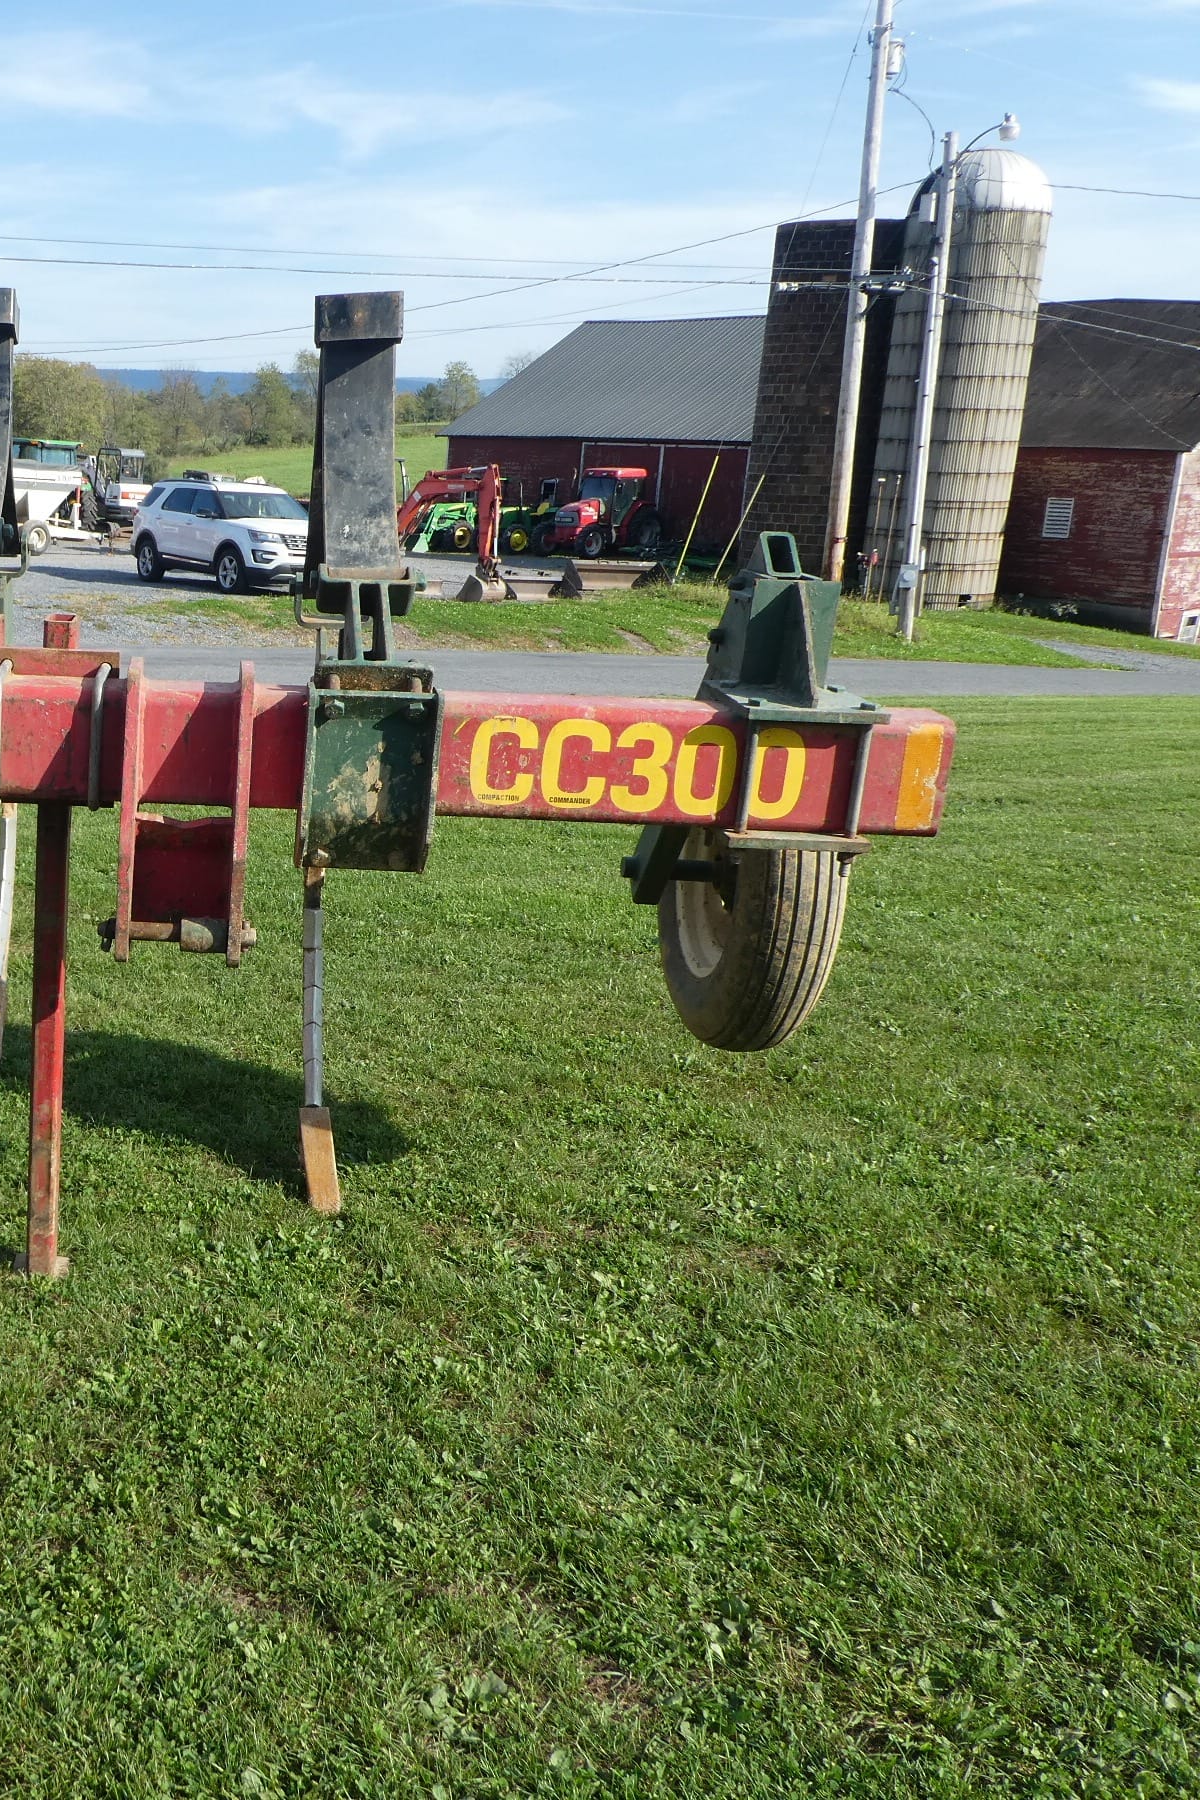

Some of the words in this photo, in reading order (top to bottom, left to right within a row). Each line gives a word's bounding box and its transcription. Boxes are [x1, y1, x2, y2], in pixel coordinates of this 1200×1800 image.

[469, 714, 807, 820] CC300
[477, 793, 520, 802] COMPACTION
[549, 796, 591, 805] COMMANDER
